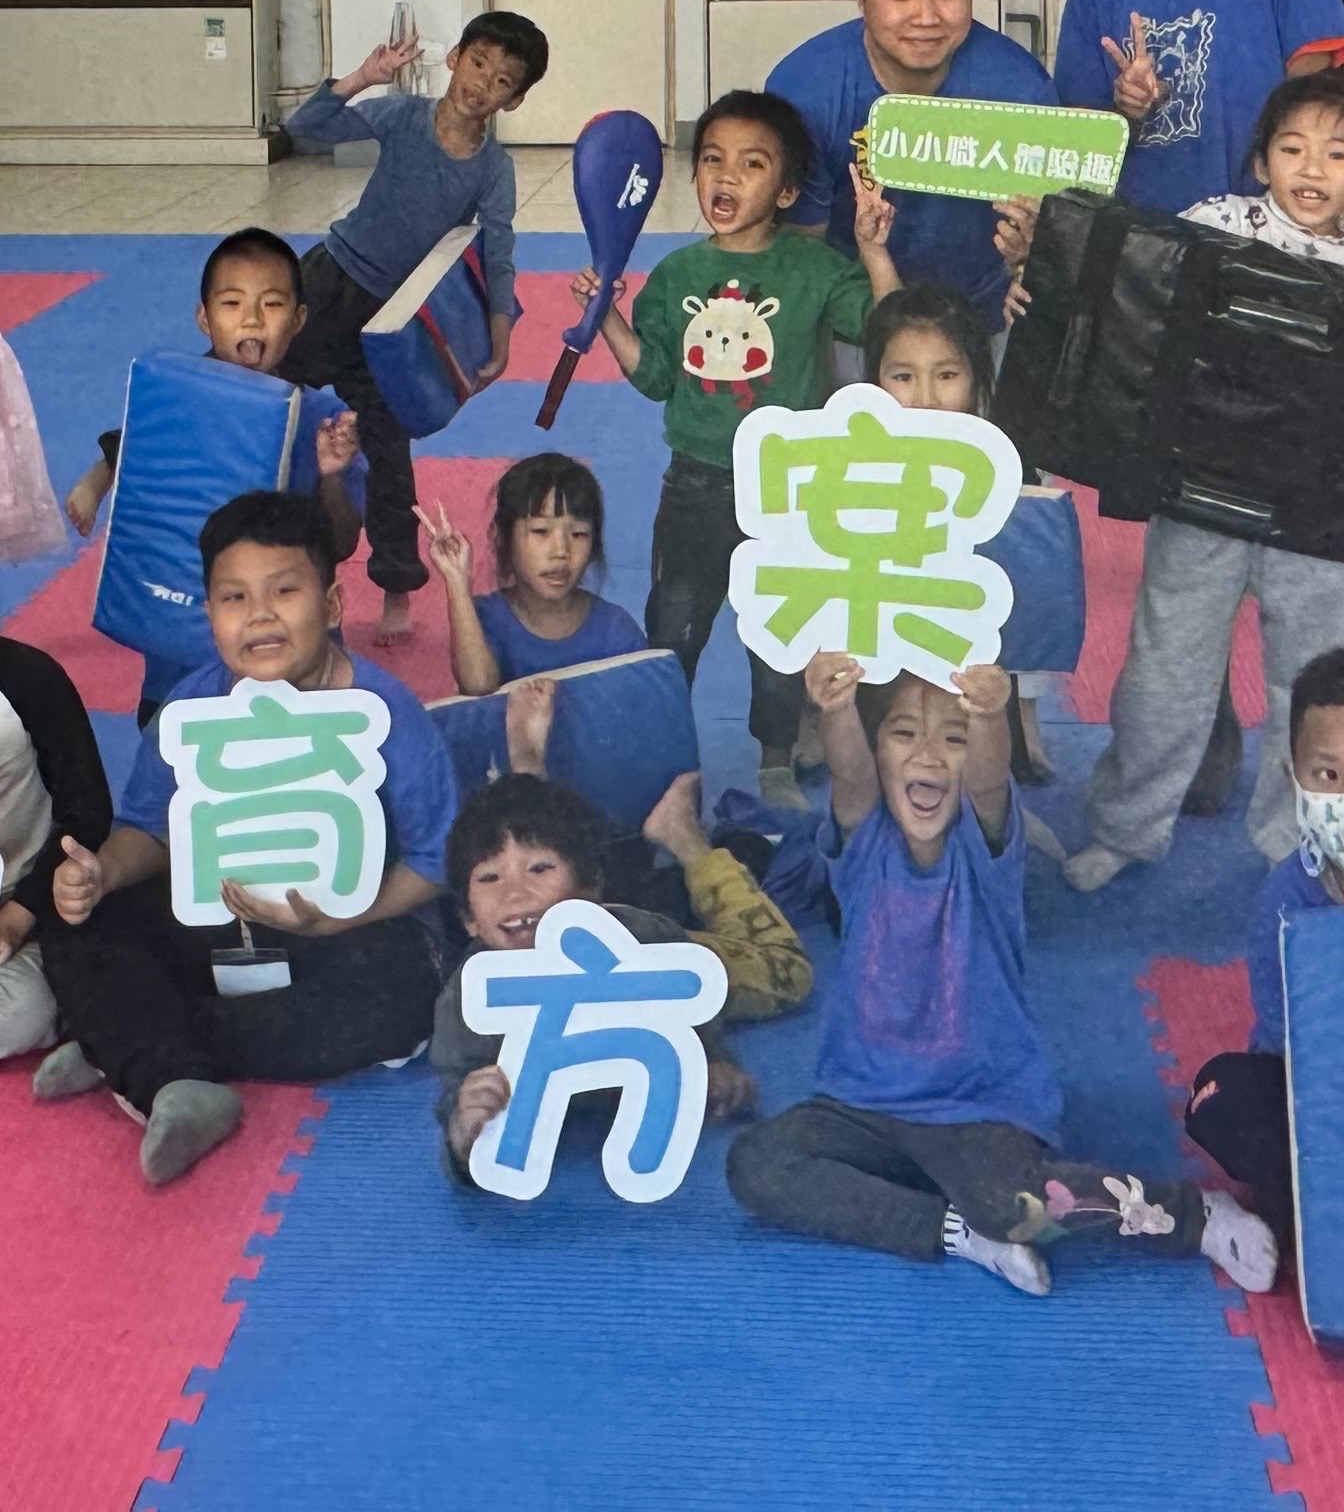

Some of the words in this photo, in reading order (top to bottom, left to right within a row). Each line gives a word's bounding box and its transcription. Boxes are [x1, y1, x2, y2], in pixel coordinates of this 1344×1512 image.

[754, 411, 995, 666] 案
[178, 692, 370, 908] 育
[484, 924, 703, 1176] 方
